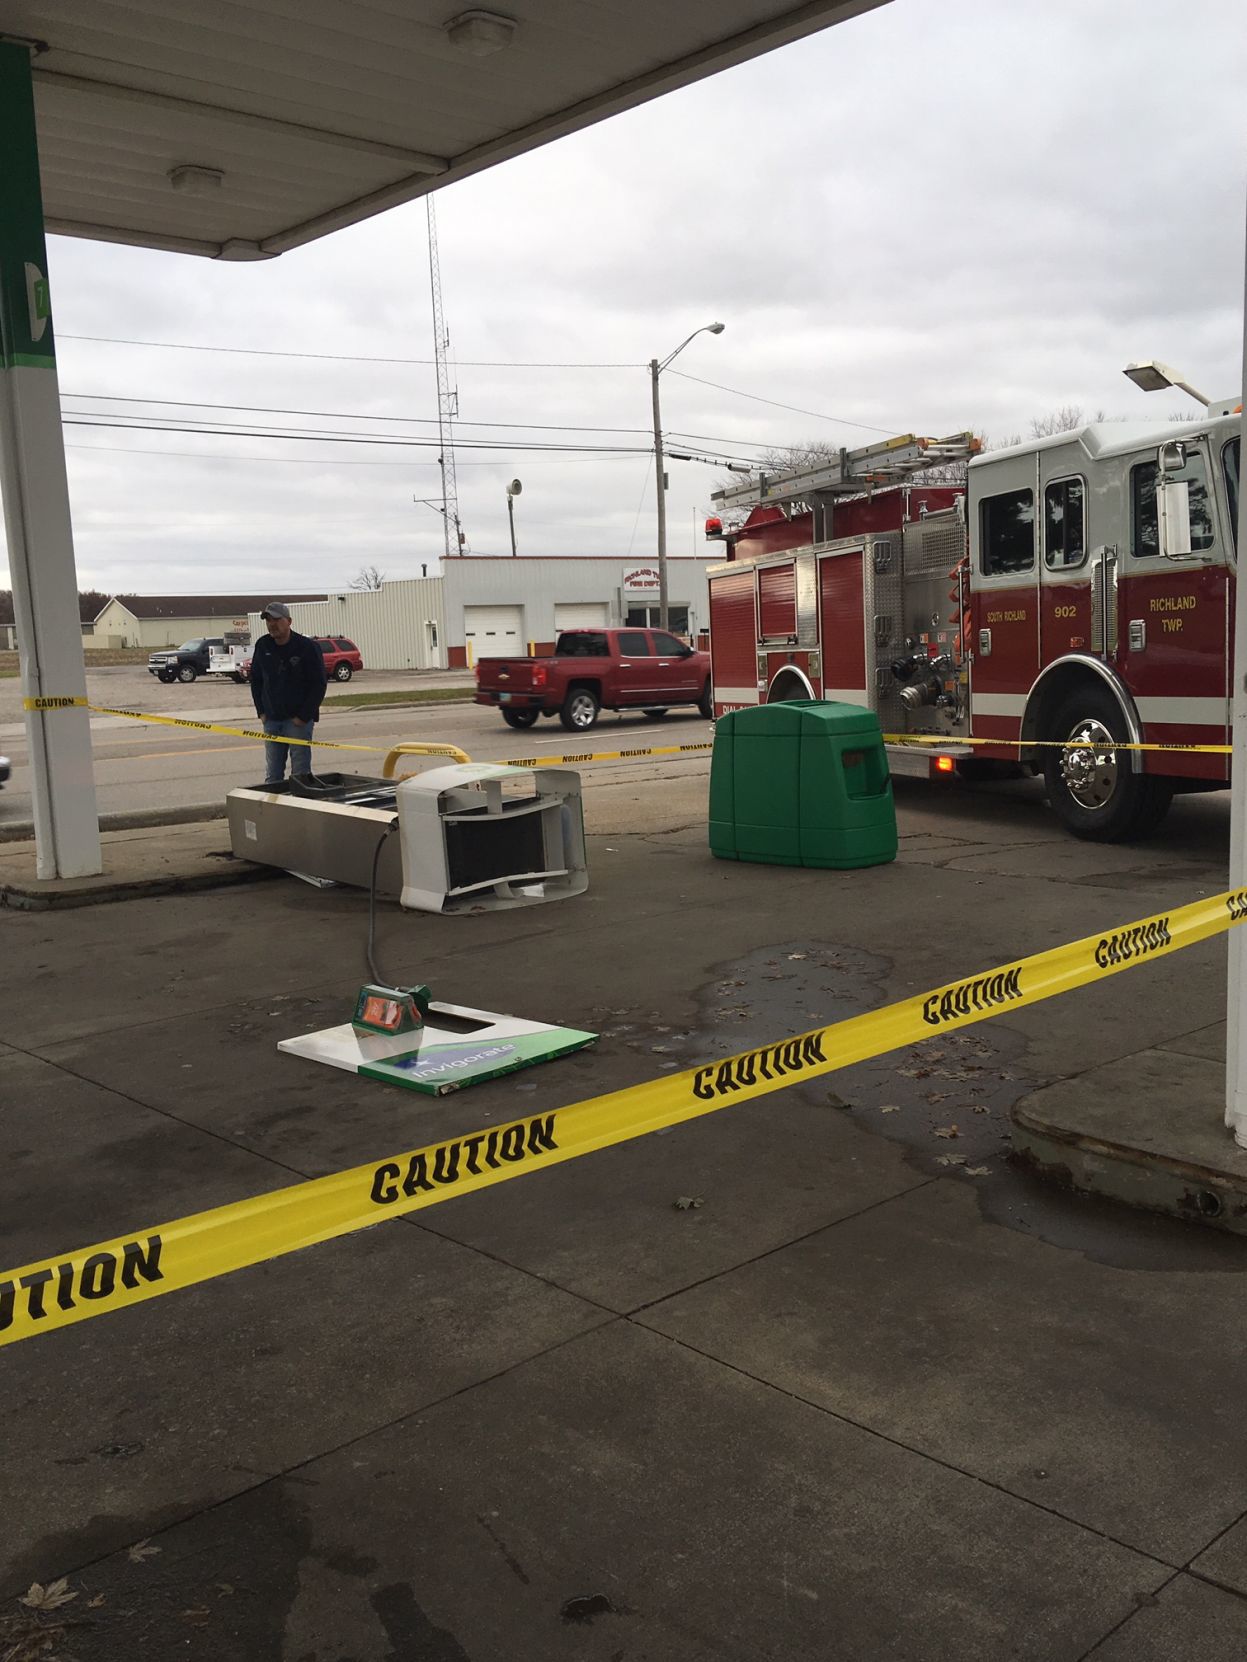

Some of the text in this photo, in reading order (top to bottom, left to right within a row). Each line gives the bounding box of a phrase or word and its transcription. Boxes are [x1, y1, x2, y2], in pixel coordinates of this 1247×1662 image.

[1150, 596, 1196, 611] RICHLAND
[987, 610, 1026, 623] SOUTH RICHLAND
[1054, 605, 1077, 618] 902
[1161, 618, 1183, 632] TWP.
[35, 697, 75, 708] CAUTION
[562, 753, 593, 763] CAUTION
[620, 748, 652, 757] CAUTION
[507, 758, 537, 767] CAUTION
[1094, 917, 1172, 969] CAUTION
[922, 967, 1024, 1025] CAUTION
[692, 1031, 828, 1100] CAUTION
[370, 1114, 559, 1205] CAUTION
